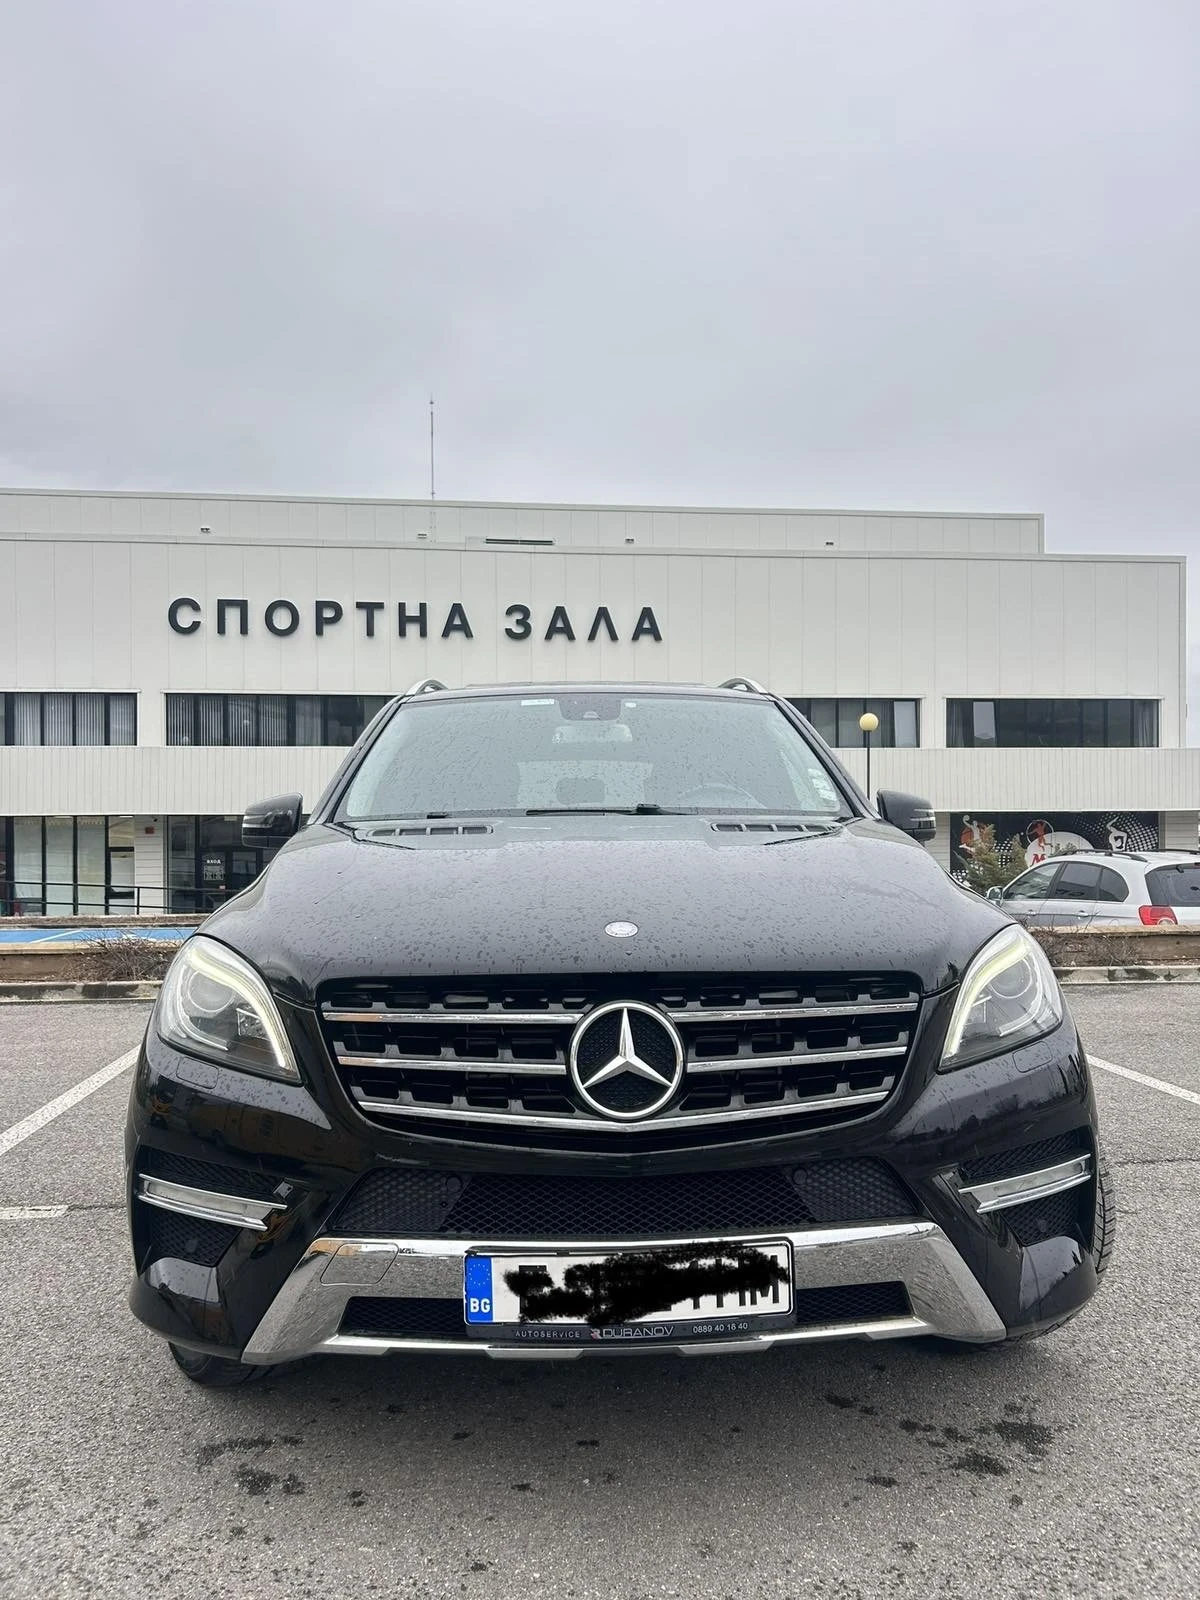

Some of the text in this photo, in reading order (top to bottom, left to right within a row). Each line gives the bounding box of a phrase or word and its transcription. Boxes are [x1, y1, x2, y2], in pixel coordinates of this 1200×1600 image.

[167, 598, 663, 642] СПОРТНА ЗАЛА
[470, 1298, 491, 1313] BG
[602, 1326, 674, 1338] DURANOV
[692, 1322, 748, 1334] 0889 40 16 40
